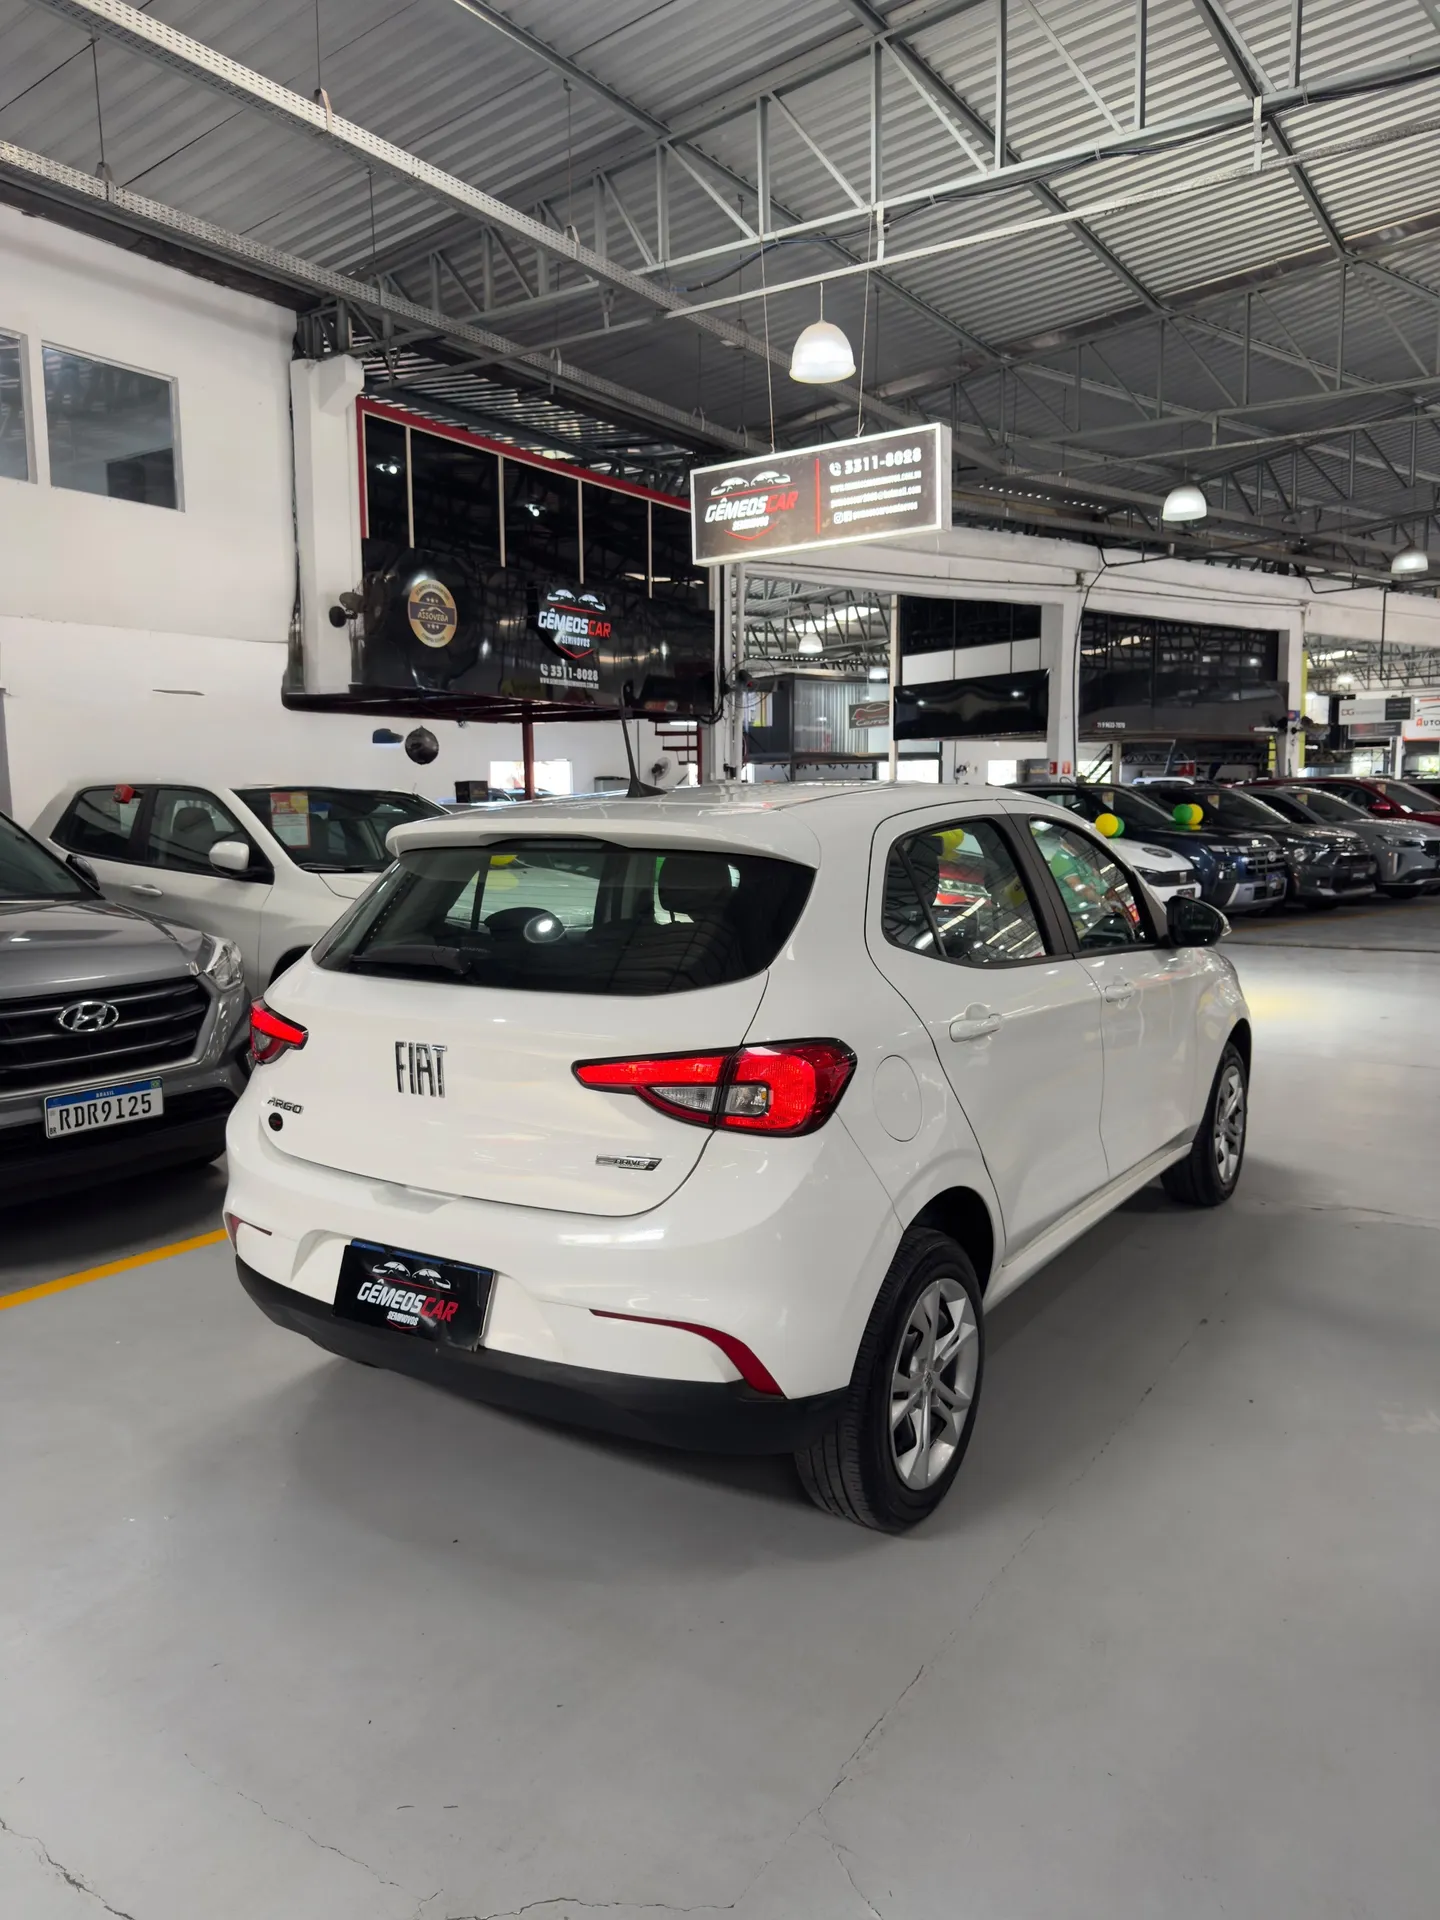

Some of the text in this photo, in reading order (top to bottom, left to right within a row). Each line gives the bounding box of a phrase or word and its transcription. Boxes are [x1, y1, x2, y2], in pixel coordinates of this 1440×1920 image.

[844, 447, 922, 475] 3311-8028
[417, 611, 449, 622] ASSOVEBA
[561, 635, 591, 648] SEMINOVOS
[550, 664, 599, 681] 3311-8028
[395, 1040, 448, 1098] FIAT
[95, 1090, 115, 1098] BRASIL
[59, 1092, 152, 1131] RDR9I25
[266, 1096, 304, 1114] ARGO
[49, 1126, 57, 1135] BR
[356, 1278, 460, 1322] GÊMEOSCAR
[386, 1310, 420, 1326] SEMINOVOS
